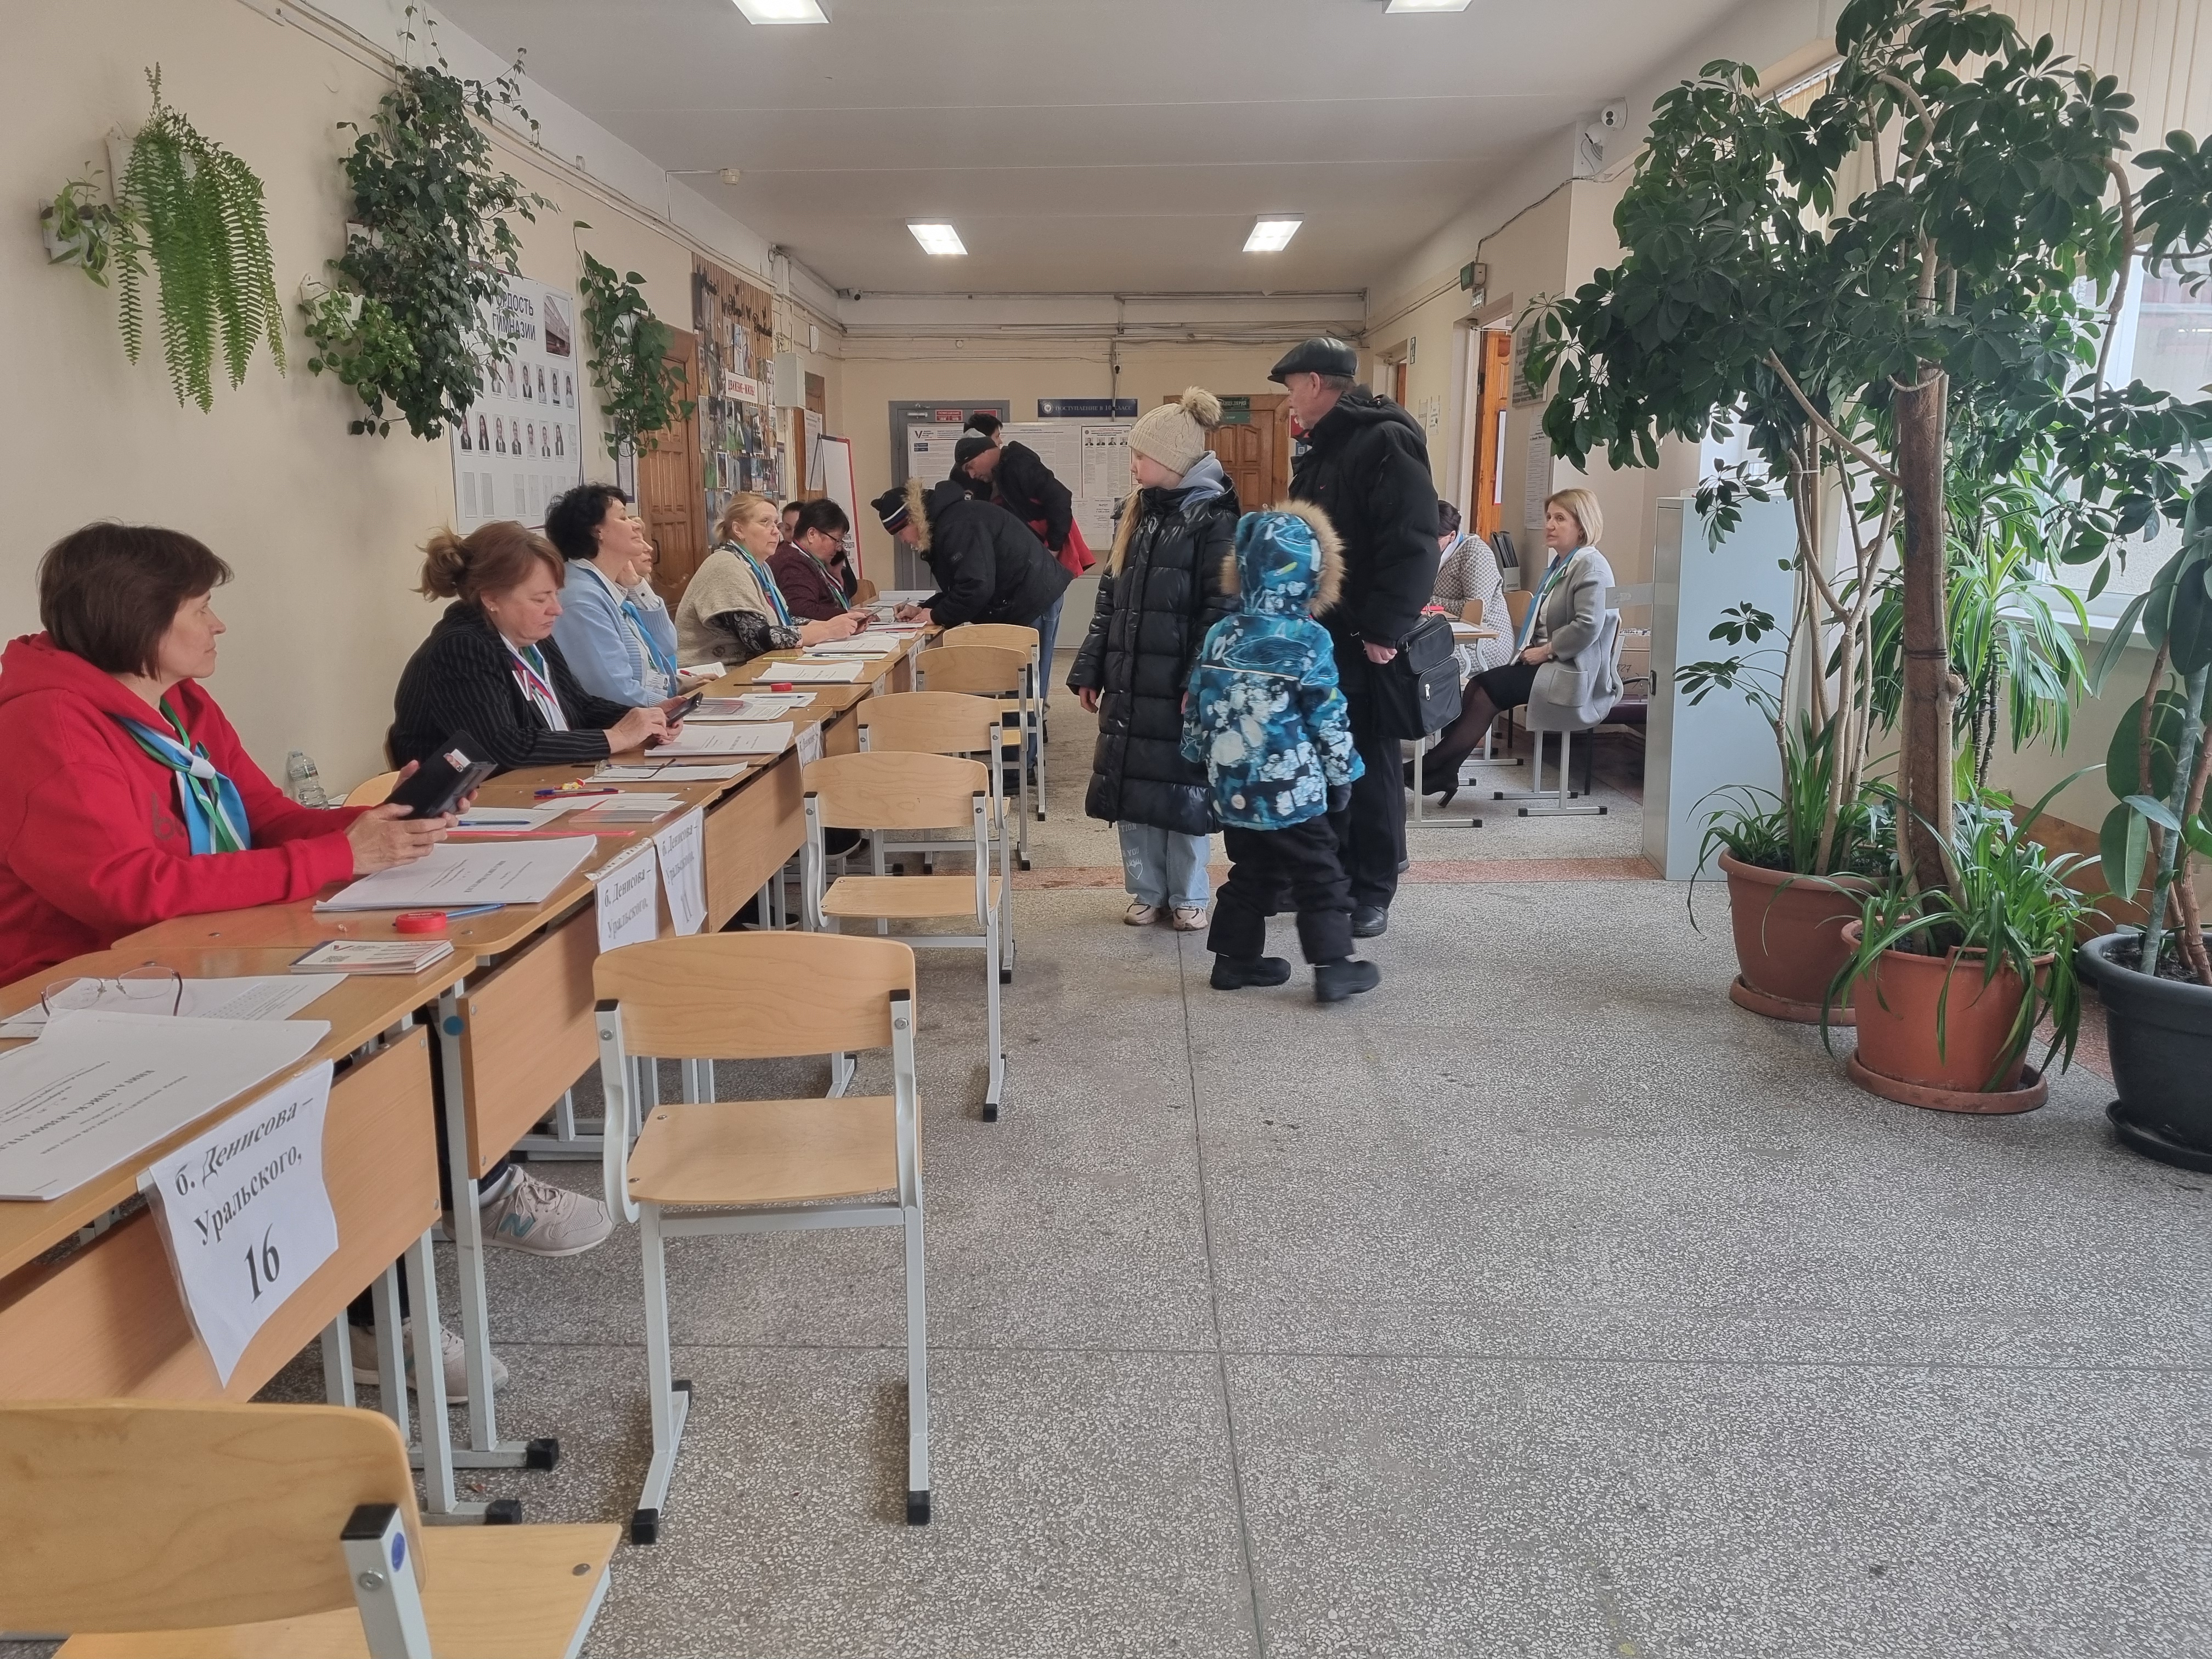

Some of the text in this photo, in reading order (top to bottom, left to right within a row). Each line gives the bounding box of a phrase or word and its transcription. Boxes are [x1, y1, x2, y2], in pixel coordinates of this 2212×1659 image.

[492, 313, 535, 341] ГИМНАЗИИ
[668, 825, 692, 851] Денисова
[1120, 823, 1137, 833] TION
[1127, 847, 1139, 857] YOU
[613, 868, 645, 902] Денисова
[115, 1070, 155, 1088] КНИГА
[67, 1088, 117, 1115] СПИСКА
[176, 1163, 195, 1196] б.
[202, 1102, 297, 1189] Денисова
[193, 1146, 302, 1246] Уральского,
[244, 1222, 280, 1304] 16
